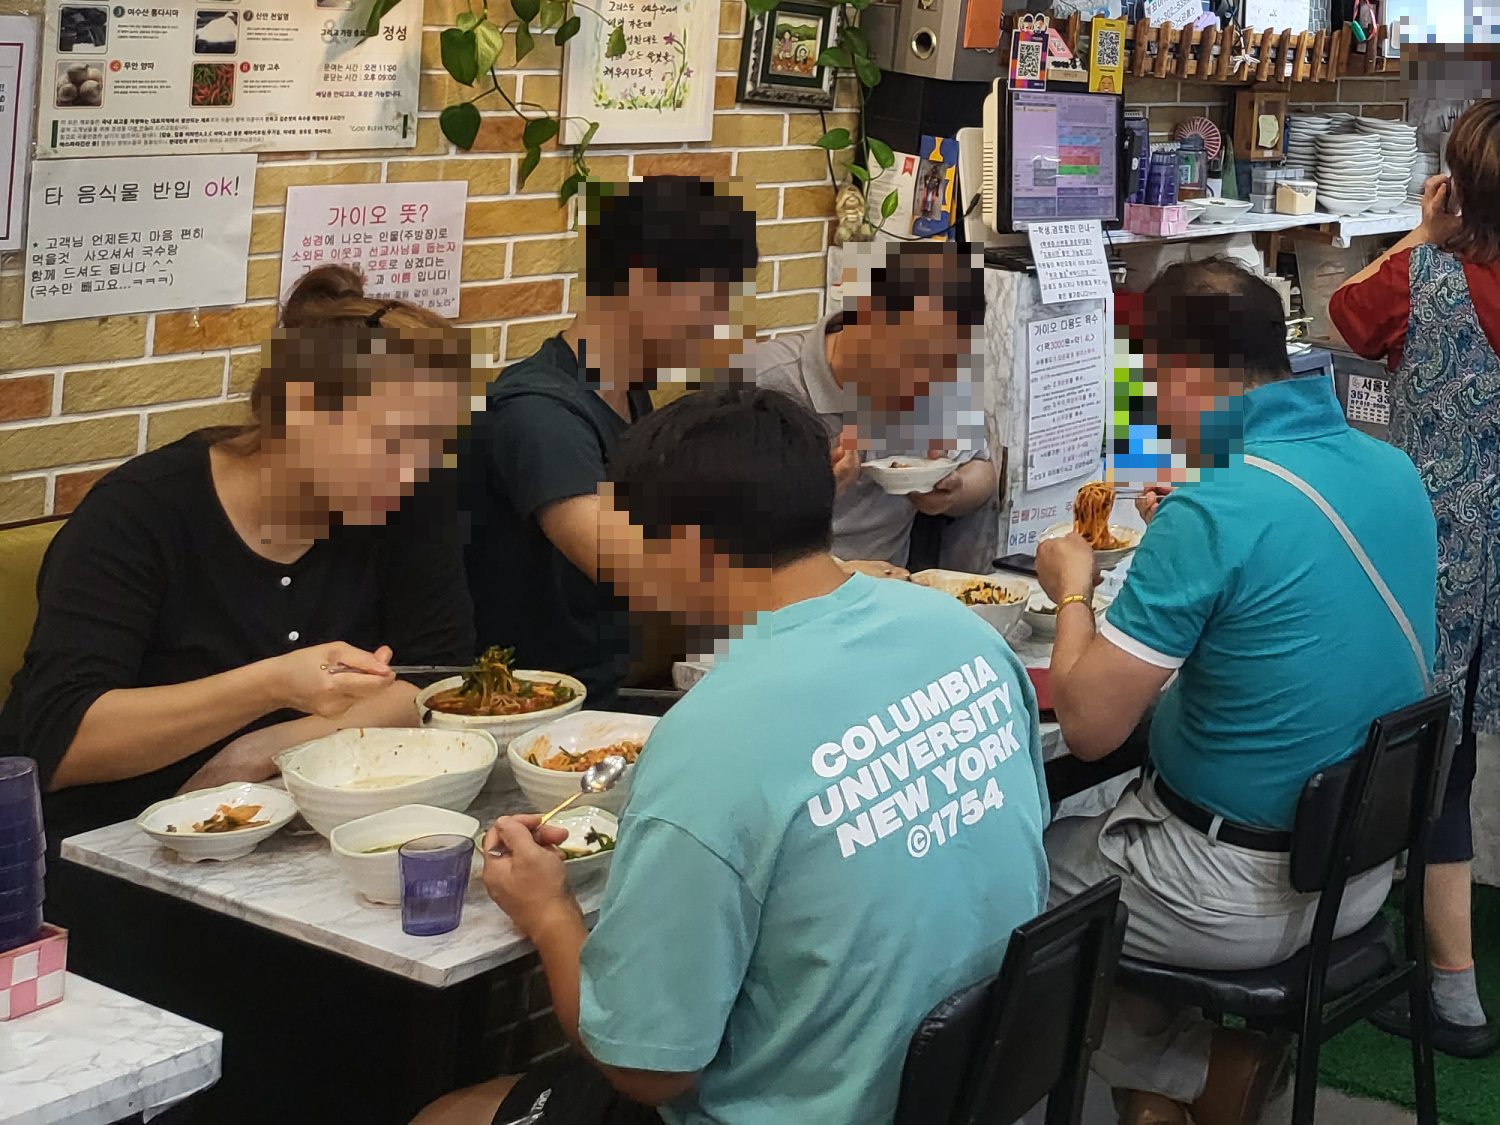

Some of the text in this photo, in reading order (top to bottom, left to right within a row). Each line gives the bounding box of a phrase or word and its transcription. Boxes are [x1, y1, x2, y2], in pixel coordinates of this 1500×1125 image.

[382, 25, 408, 42] 정성
[45, 187, 63, 206] 타
[78, 183, 140, 204] 음식물
[153, 181, 191, 200] 반입
[327, 204, 429, 227] 가이오 뜻?
[46, 228, 204, 249] 고객님 언제든지 마음 편히
[302, 234, 334, 246] 성경에
[341, 232, 373, 244] 나오는
[32, 245, 178, 265] 먹을것 사오셔서 국수랑
[291, 249, 323, 262] 소외된
[331, 247, 362, 260] 이웃과
[369, 244, 420, 257] 선교사님을
[32, 269, 56, 282] 함께
[63, 266, 101, 279] 드셔도
[110, 262, 146, 275] 됩니다
[367, 260, 398, 271] 모토로
[1034, 313, 1098, 336] 가이오 다용도 육수
[1010, 530, 1037, 546] 어려운
[811, 655, 999, 778] COLUMBIA
[807, 682, 1012, 827] UNIVERSITY
[836, 720, 1021, 858] NEW YORK
